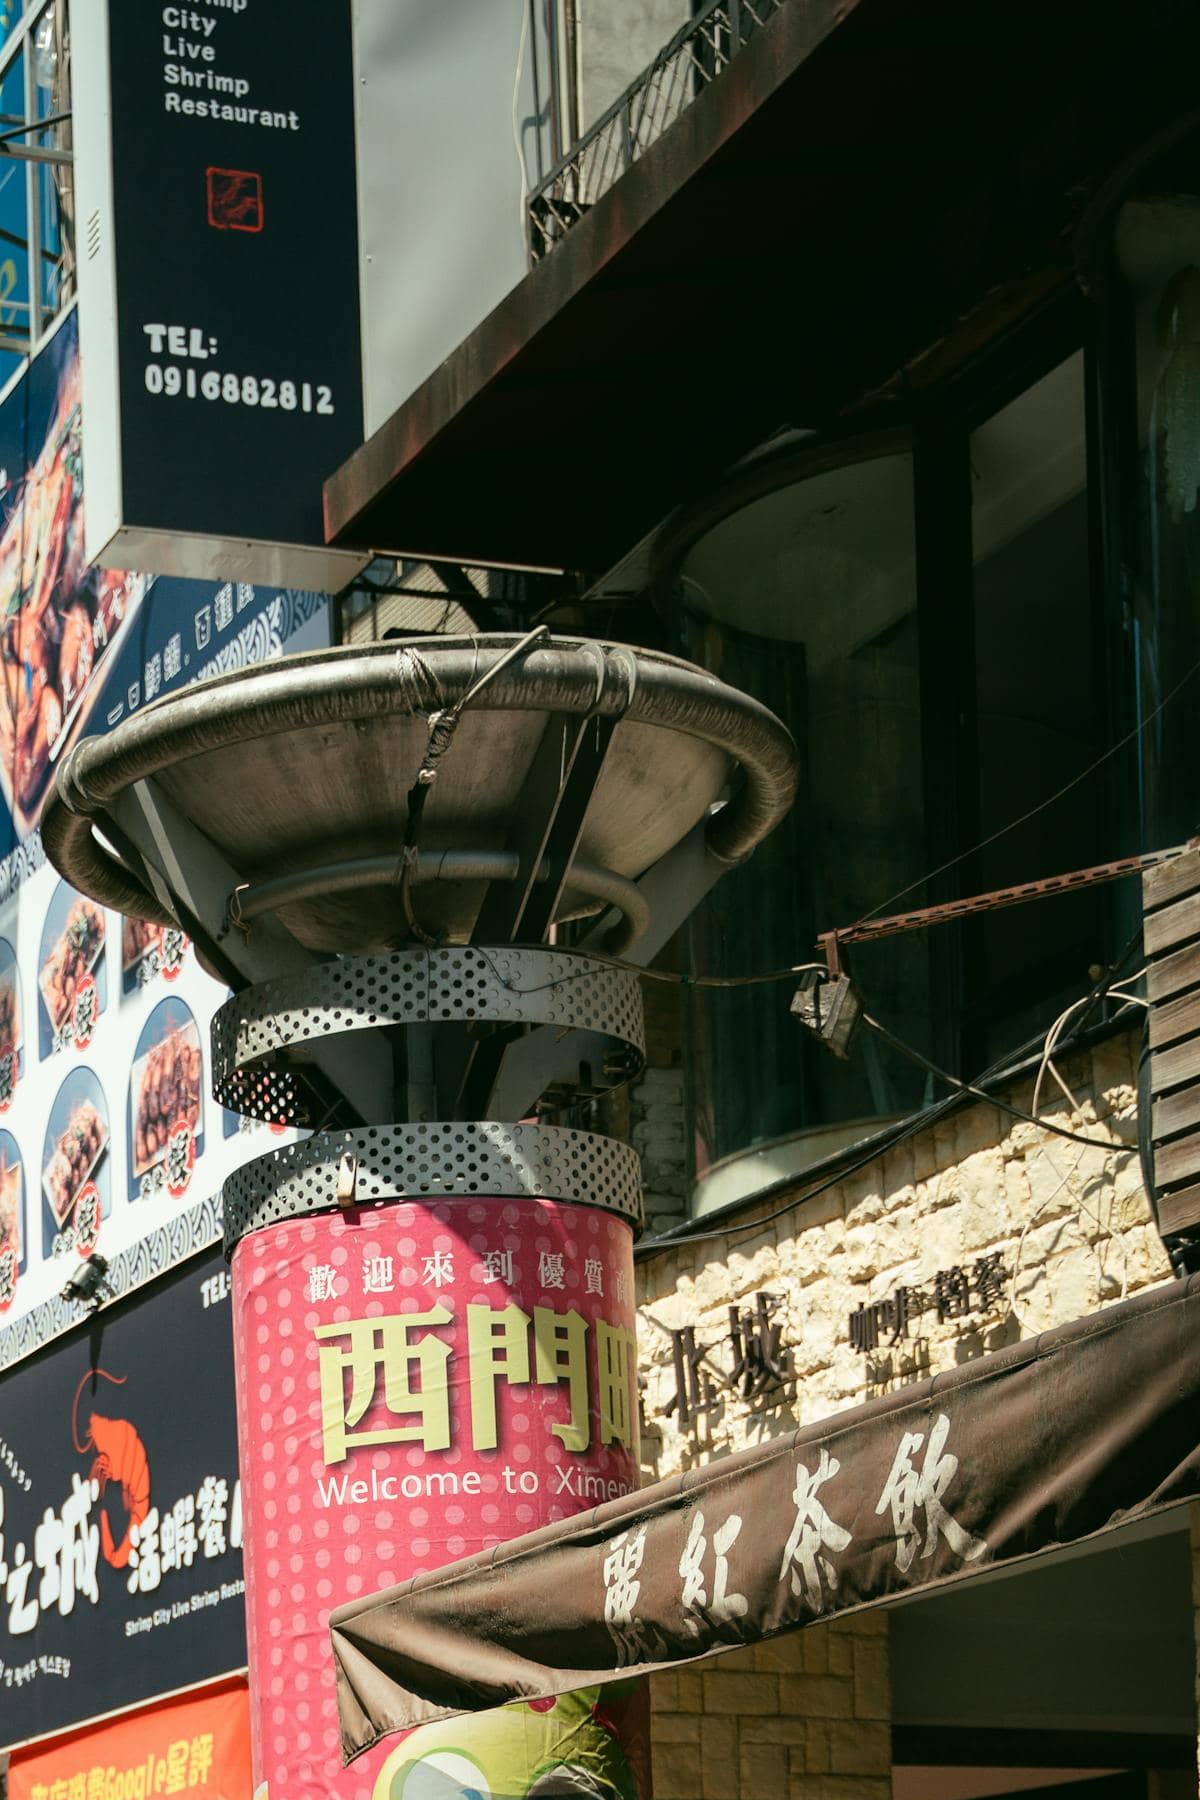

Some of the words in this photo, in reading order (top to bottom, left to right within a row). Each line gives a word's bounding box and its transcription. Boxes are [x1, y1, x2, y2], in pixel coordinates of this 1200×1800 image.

[162, 7, 216, 37] City
[163, 34, 215, 61] Live
[164, 63, 249, 98] Shrimp
[165, 92, 299, 130] Restaurant
[143, 323, 217, 359] TEL:
[144, 364, 334, 414] 0916882812
[318, 1470, 482, 1508] Welcome
[502, 1466, 539, 1495] to
[127, 1475, 243, 1594] 活蝦餐
[172, 1601, 190, 1618] Live
[191, 1590, 220, 1611] Shrimp
[221, 1579, 245, 1600] Resta
